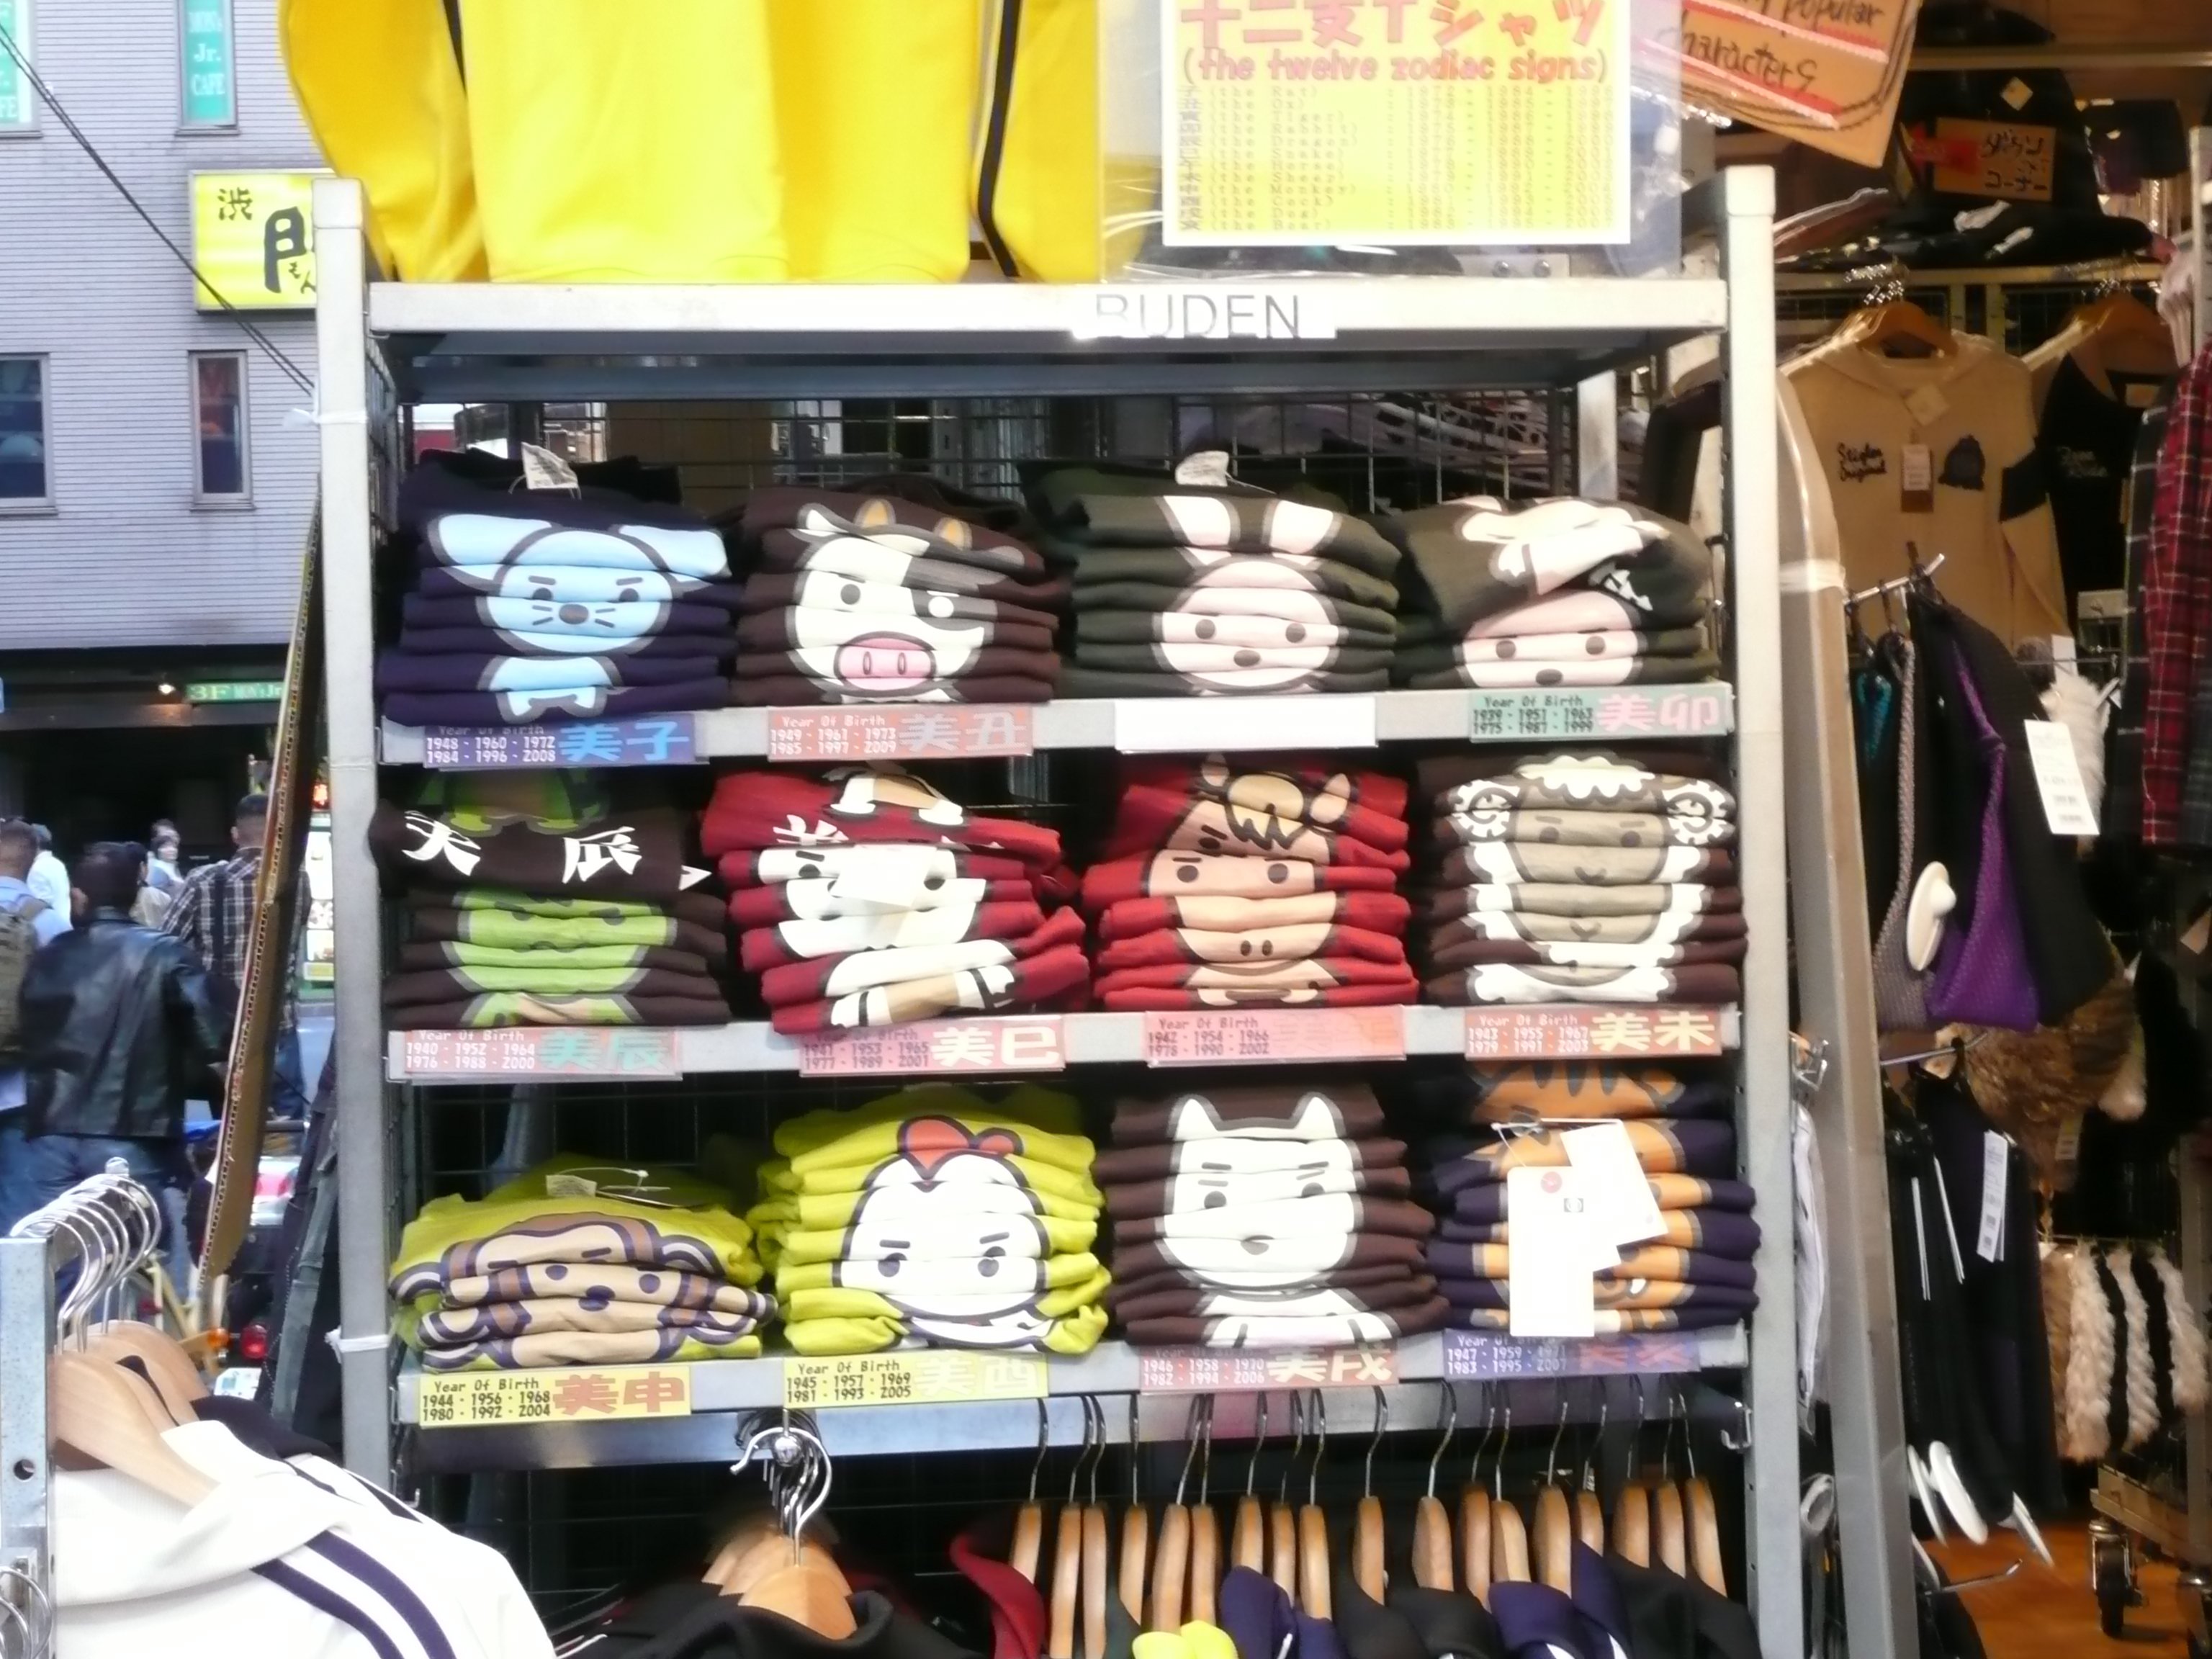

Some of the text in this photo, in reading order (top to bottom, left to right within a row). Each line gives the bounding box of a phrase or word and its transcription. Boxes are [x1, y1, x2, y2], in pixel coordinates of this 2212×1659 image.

[1269, 48, 1379, 81] twelve
[1390, 48, 1495, 81] zodiac
[426, 737, 555, 750] 1948 1960 1972
[558, 721, 690, 762] 美子
[426, 750, 555, 763] 1984 1996 2008
[1590, 1012, 1715, 1051] 美未
[407, 1043, 534, 1056] 1940 1952 1964
[407, 1056, 534, 1069] 1976 1988 2000
[798, 1361, 899, 1375] Year Of Birth
[1143, 1360, 1173, 1372] 1946
[1190, 1359, 1218, 1370] 1958
[435, 1379, 539, 1393] Year Of Birth
[786, 1373, 910, 1390] 1945 1957 1969
[1143, 1372, 1264, 1385] 1982 1994 2006
[423, 1391, 550, 1408] 1944 1956 1968
[553, 1371, 685, 1415] 美申
[787, 1387, 911, 1403] 1981 1993 2005
[423, 1405, 550, 1421] 1980 1992 2004
